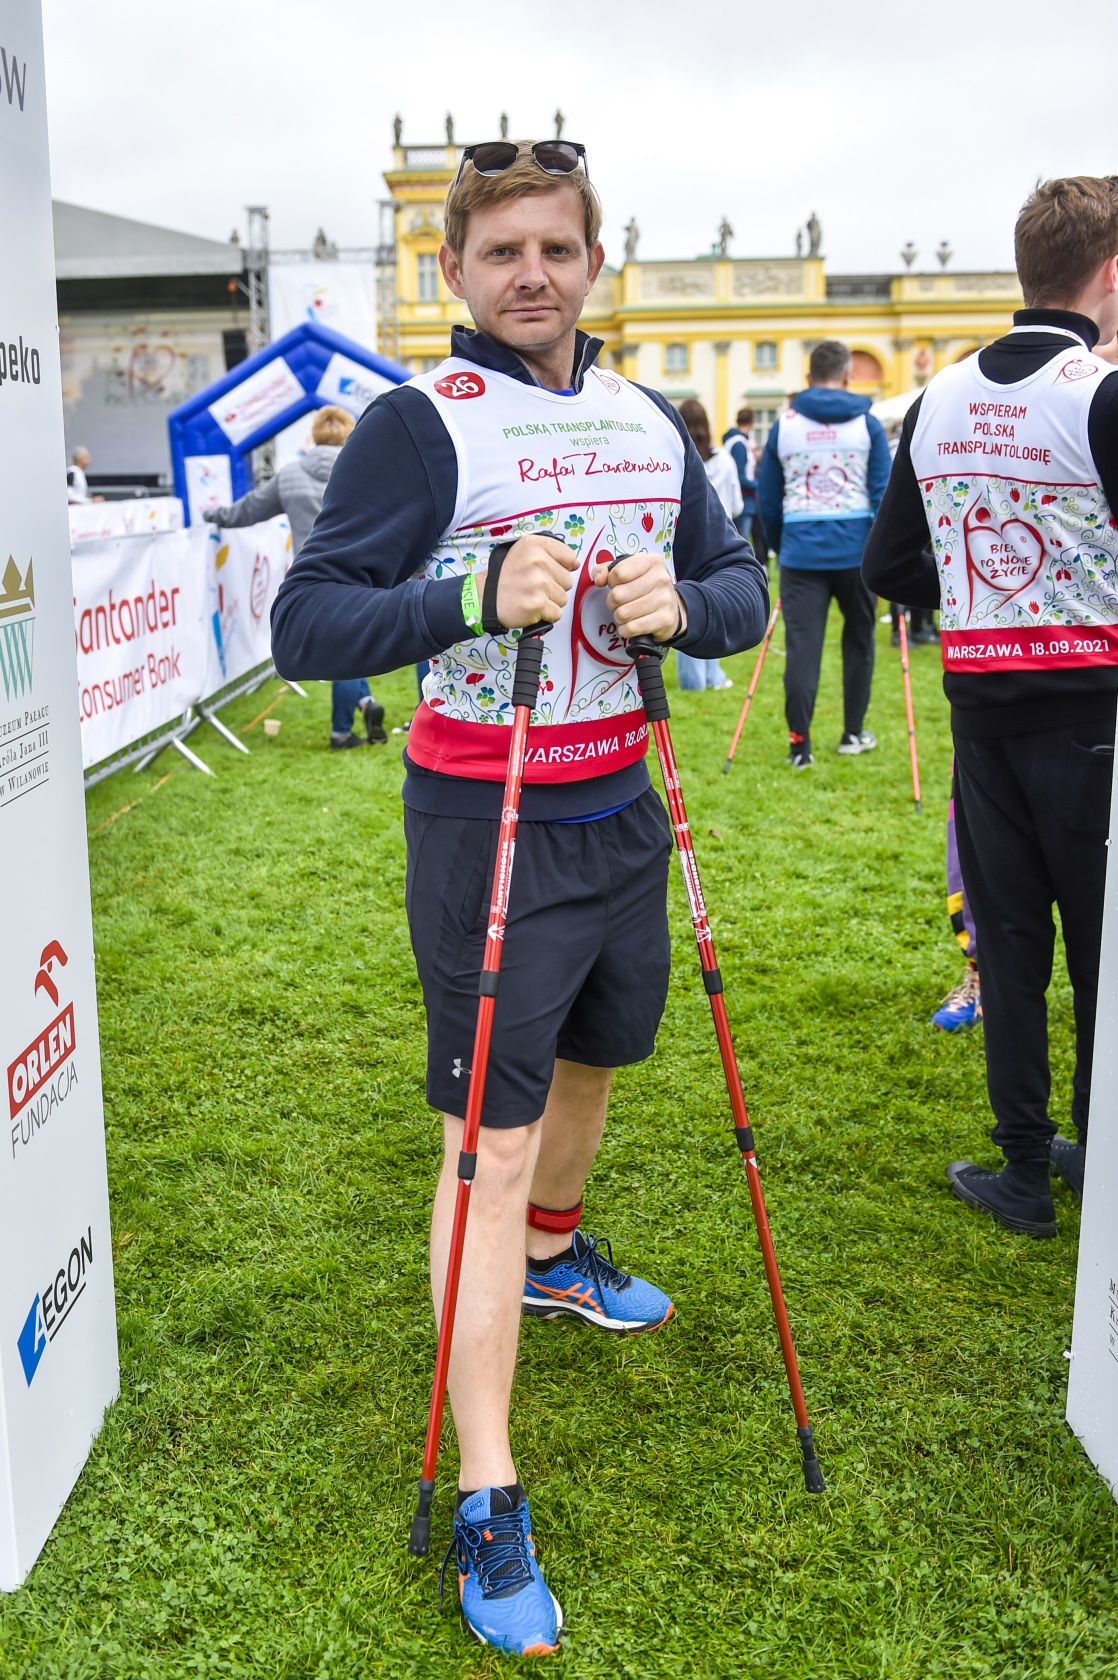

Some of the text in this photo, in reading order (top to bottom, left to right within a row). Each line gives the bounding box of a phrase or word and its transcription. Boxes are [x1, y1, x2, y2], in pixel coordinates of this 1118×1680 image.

[0, 46, 26, 112] W
[441, 376, 480, 397] 26
[969, 402, 1027, 420] WSPIERAM
[502, 419, 647, 439] POLSKĄ TRANSPLANTOLOGIĘ
[973, 422, 1015, 441] POLSKĄ
[569, 435, 610, 448] wspiera
[937, 440, 1051, 466] TRANSPLANTOLOGIĘ
[980, 558, 995, 568] PO
[990, 566, 1029, 579] ŻYCIE
[73, 579, 180, 656] antander
[598, 622, 617, 637] PO
[947, 639, 1110, 659] WARSZAWA 18.09.2021
[78, 665, 145, 722] onsumer
[0, 748, 17, 769] róla
[20, 742, 37, 759] Jana
[12, 1012, 72, 1104] ORLEN
[11, 1061, 78, 1159] FUNDACJA
[34, 1226, 93, 1355] AEGON
